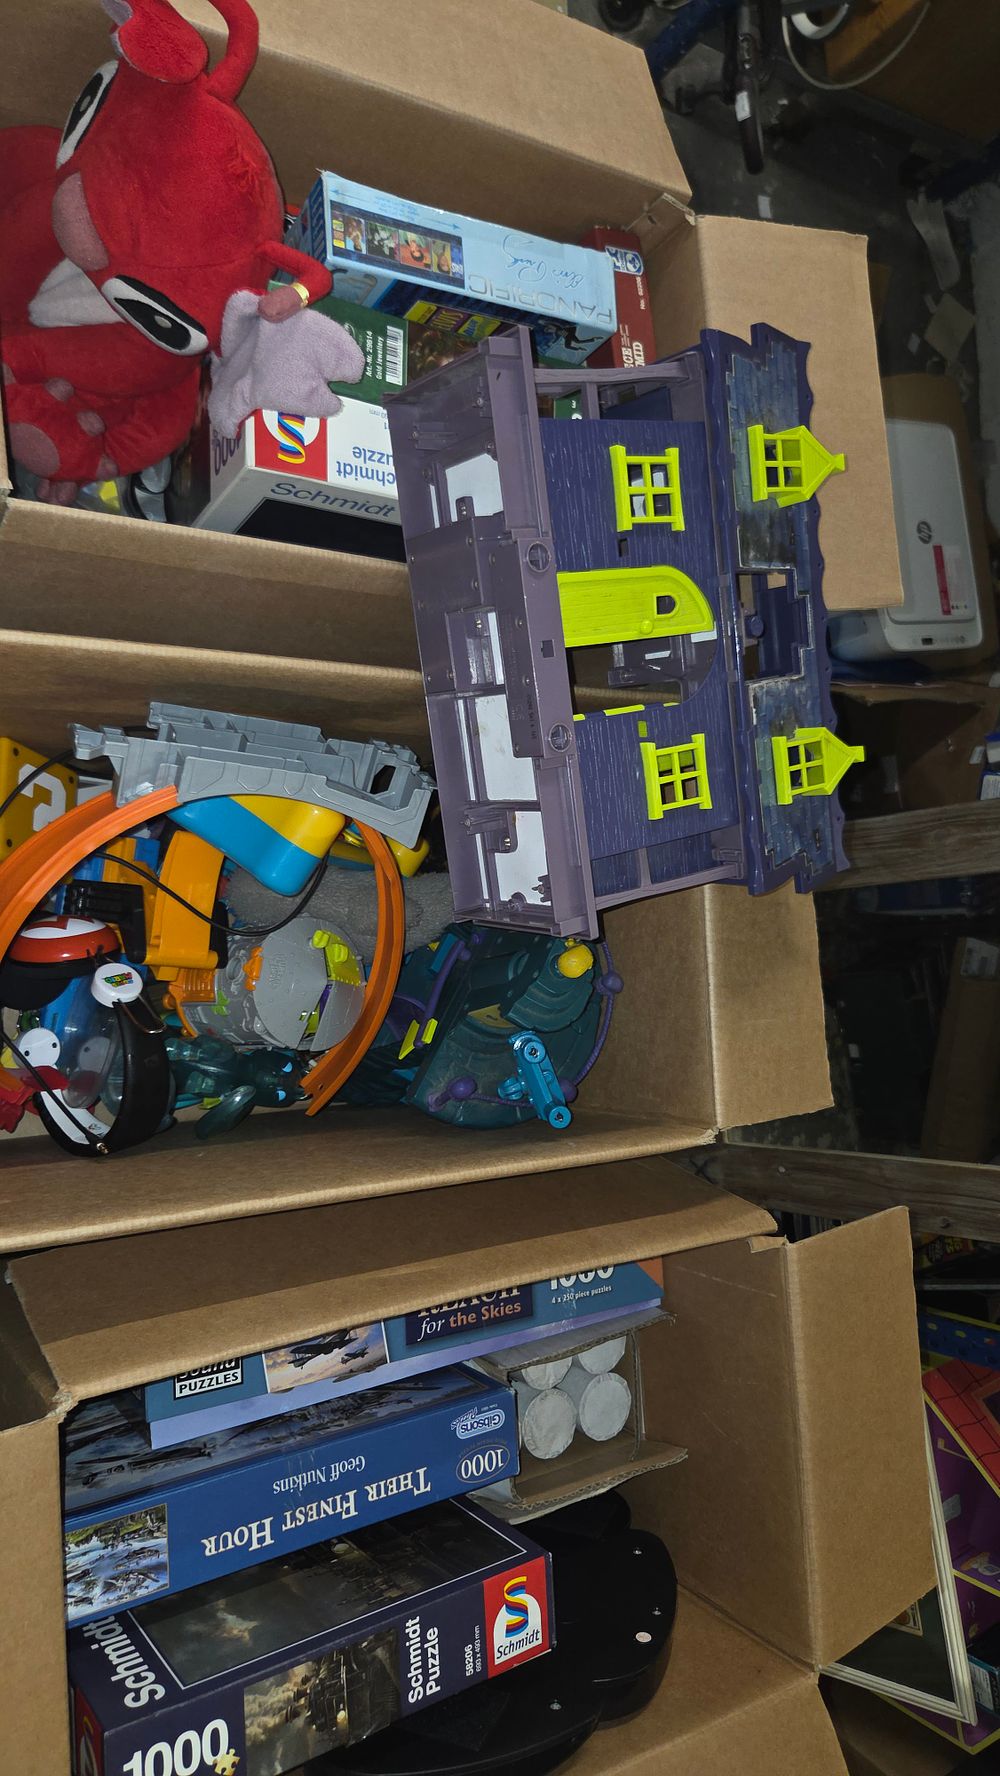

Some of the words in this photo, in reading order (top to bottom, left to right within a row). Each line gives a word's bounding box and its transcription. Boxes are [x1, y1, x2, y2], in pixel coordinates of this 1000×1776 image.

[375, 365, 383, 380] Gold
[351, 445, 394, 466] uzzle
[335, 460, 396, 488] chmidt
[270, 481, 396, 519] Schmidt
[551, 1296, 556, 1304] 4
[562, 1292, 574, 1303] 250
[574, 1290, 590, 1300] piece
[591, 1285, 612, 1297] puzzles
[417, 1317, 446, 1342] for
[449, 1311, 478, 1329] the
[480, 1301, 522, 1321] Skies
[179, 1371, 239, 1394] PUZZLES
[460, 1413, 501, 1434] Gibsons
[329, 1455, 366, 1482] Geoff
[461, 1448, 504, 1479] 1000
[273, 1467, 327, 1495] Nutkins
[364, 1466, 432, 1502] THEIR
[281, 1489, 359, 1532] FINEST
[201, 1516, 275, 1557] HOUR
[474, 1624, 480, 1639] mm
[495, 1629, 540, 1660] Schmidt
[82, 1615, 166, 1708] Schmidt
[405, 1615, 424, 1704] Schmidt
[424, 1626, 441, 1696] Puzzle
[464, 1643, 474, 1677] 58206
[122, 1718, 230, 1776] 1000
